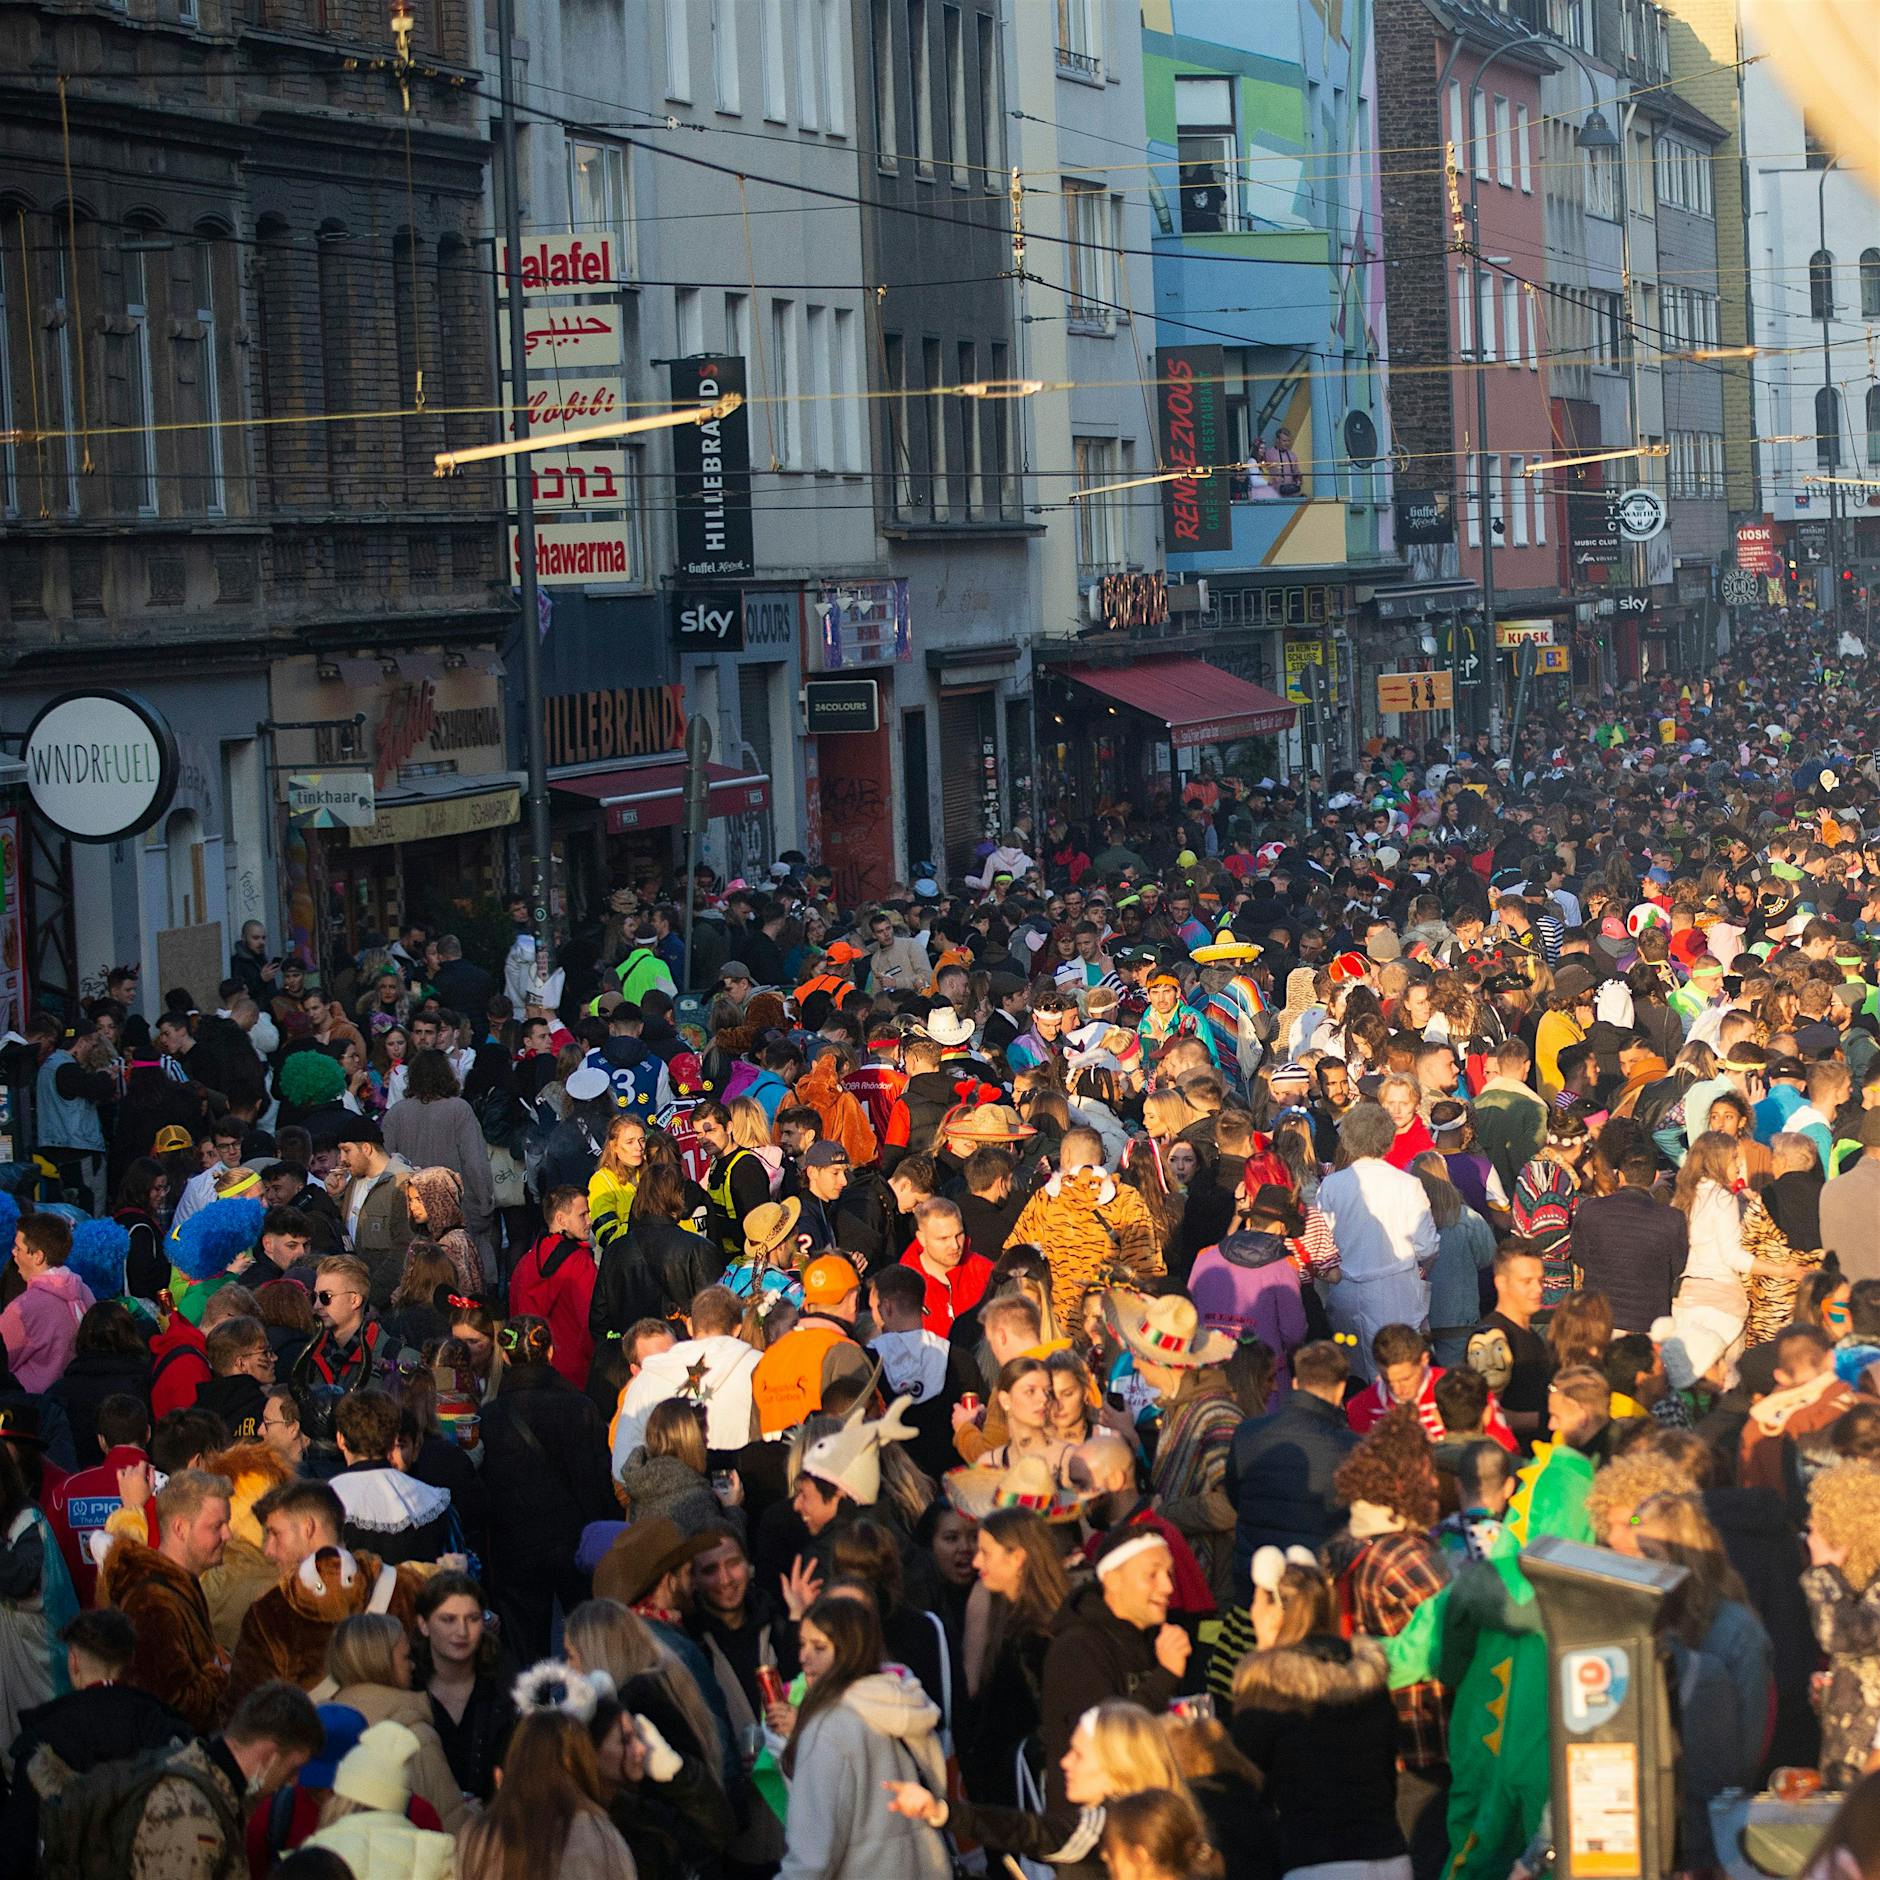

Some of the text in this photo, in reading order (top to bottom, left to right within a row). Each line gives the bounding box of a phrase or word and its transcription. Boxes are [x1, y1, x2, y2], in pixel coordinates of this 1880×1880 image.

[696, 364, 726, 550] HILLEBRADS
[1167, 357, 1200, 541] RENEZVOUS
[1410, 505, 1438, 518] Gaffel
[1736, 529, 1770, 541] KIOSK
[688, 561, 716, 574] Gaffel
[1619, 595, 1648, 613] sky
[680, 604, 734, 639] sky
[815, 702, 867, 712] 24COLOURS
[30, 743, 156, 786] WNDRFUEL
[297, 790, 358, 805] tinkhaar
[611, 1068, 636, 1105] 3
